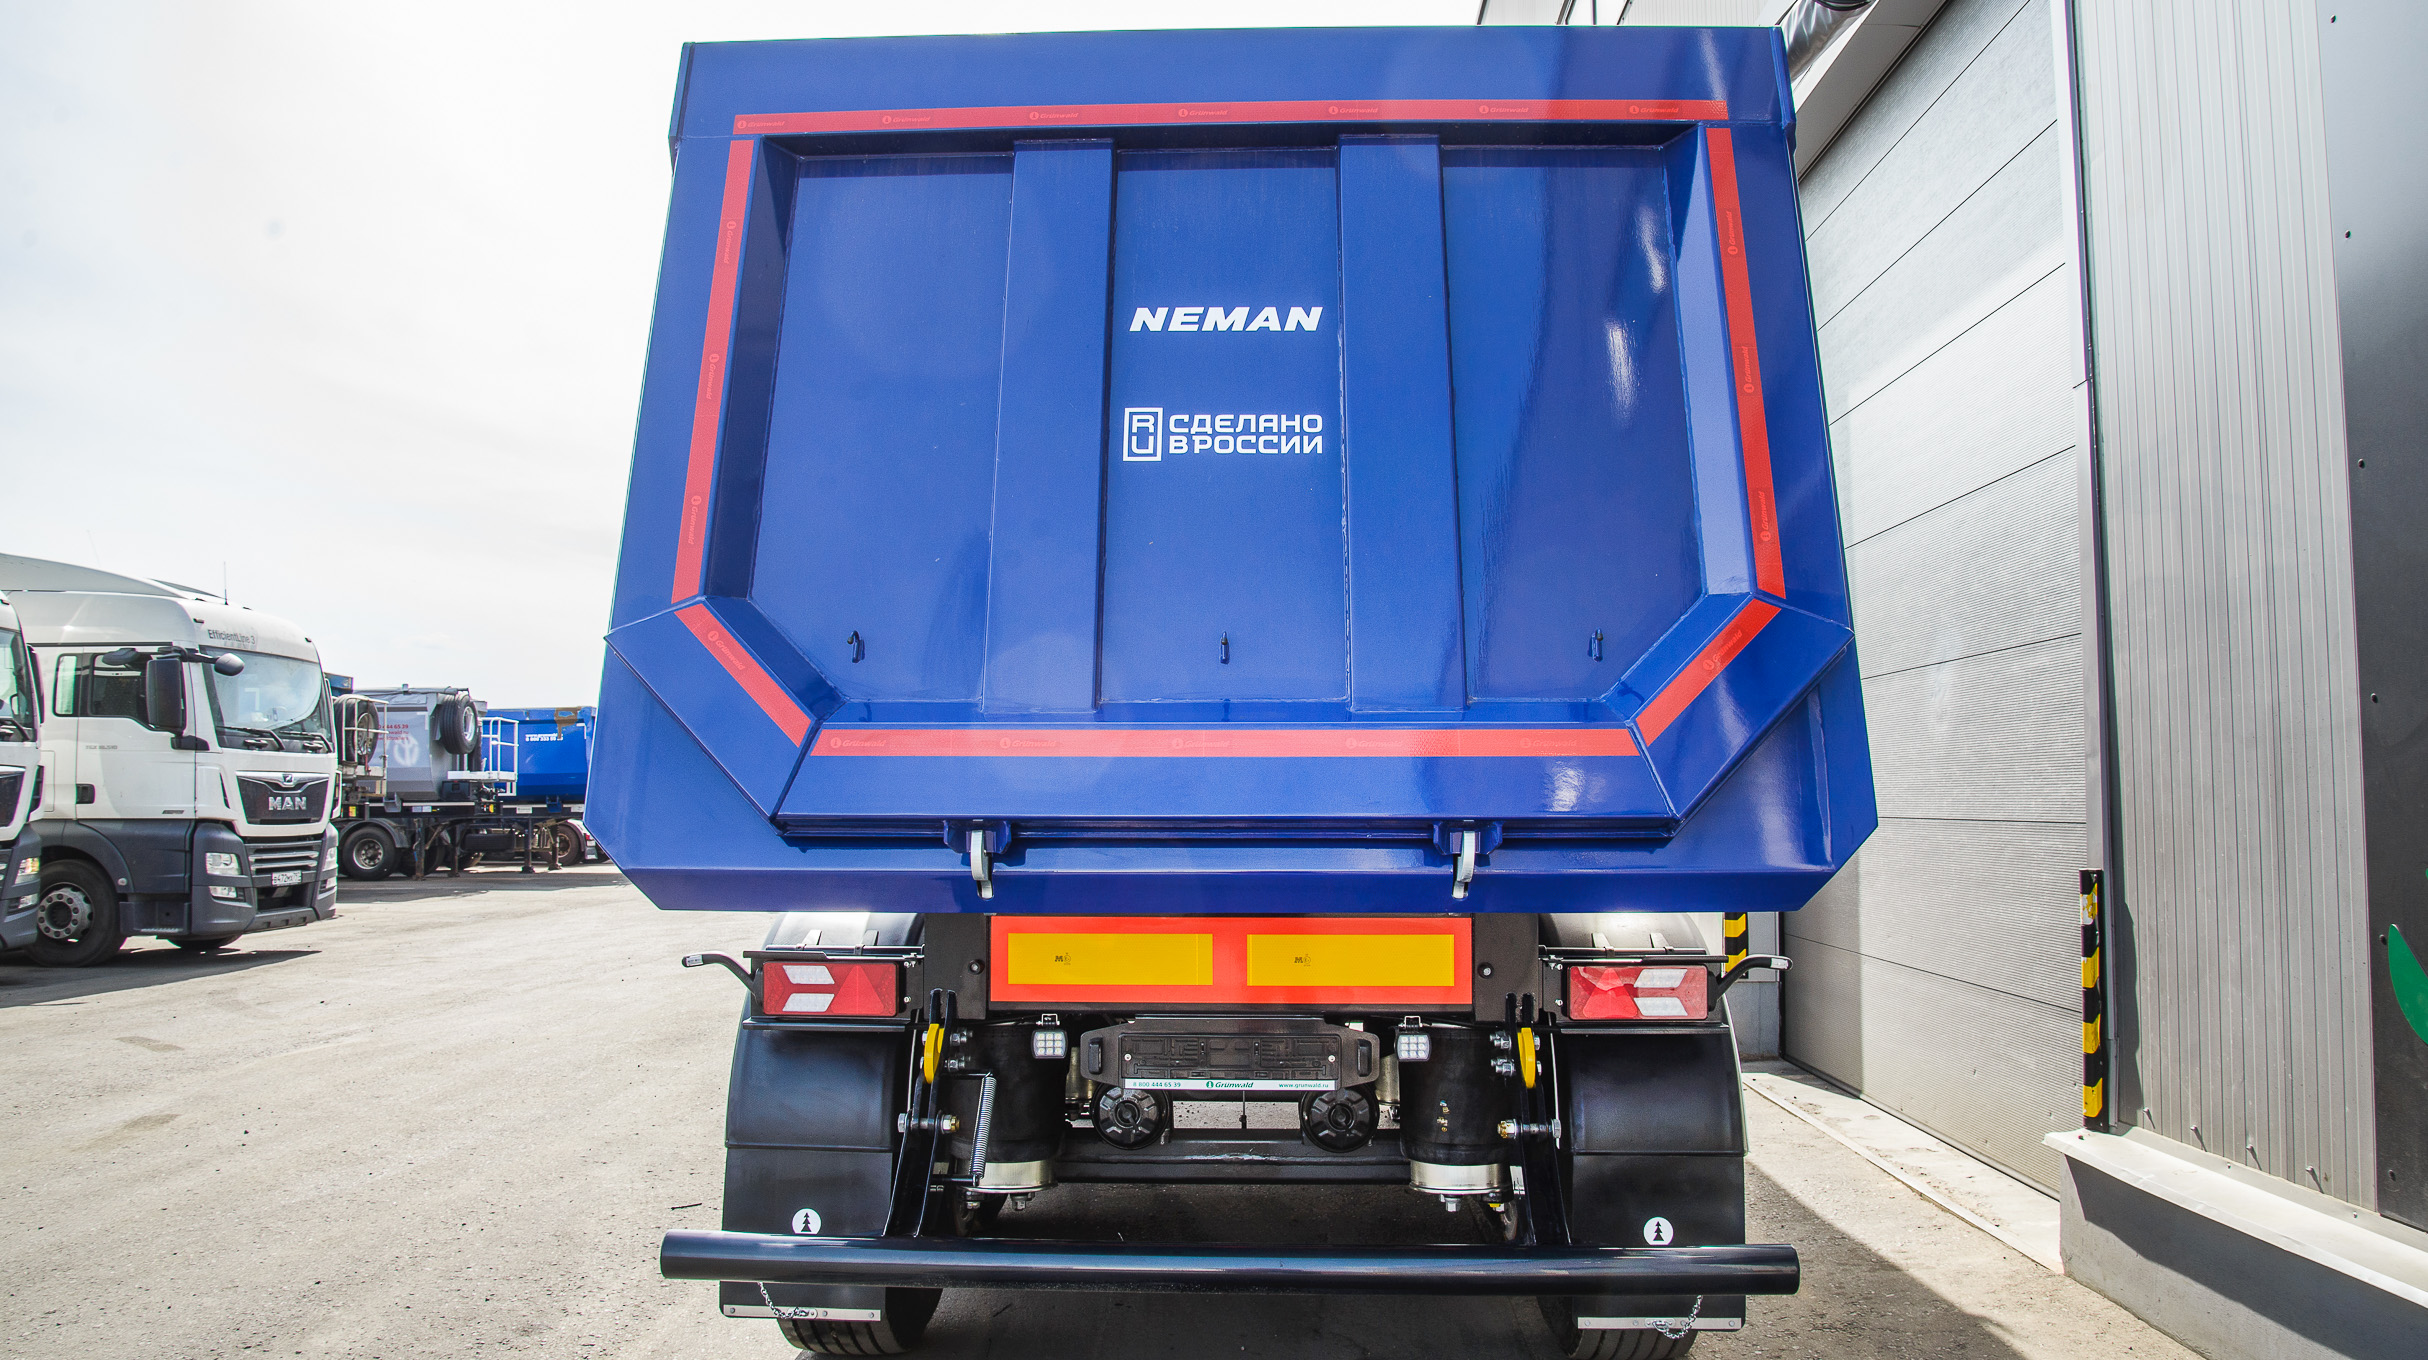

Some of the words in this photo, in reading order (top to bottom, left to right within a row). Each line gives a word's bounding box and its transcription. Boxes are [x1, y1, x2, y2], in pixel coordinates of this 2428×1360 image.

[1189, 108, 1228, 117] Grünwald
[1339, 106, 1378, 114] Grünwald
[1489, 106, 1529, 114] Grünwald
[1640, 106, 1679, 114] Grünwald
[892, 115, 931, 124] Grünwald
[1040, 111, 1079, 120] Grünwald
[747, 119, 786, 128] Grünwald
[1129, 307, 1323, 332] NEMAN
[1169, 414, 1323, 434] СДЕЛАНО
[1169, 435, 1189, 454] В
[1193, 435, 1323, 454] РОССИИ
[250, 635, 256, 644] 3
[268, 796, 307, 810] MAN
